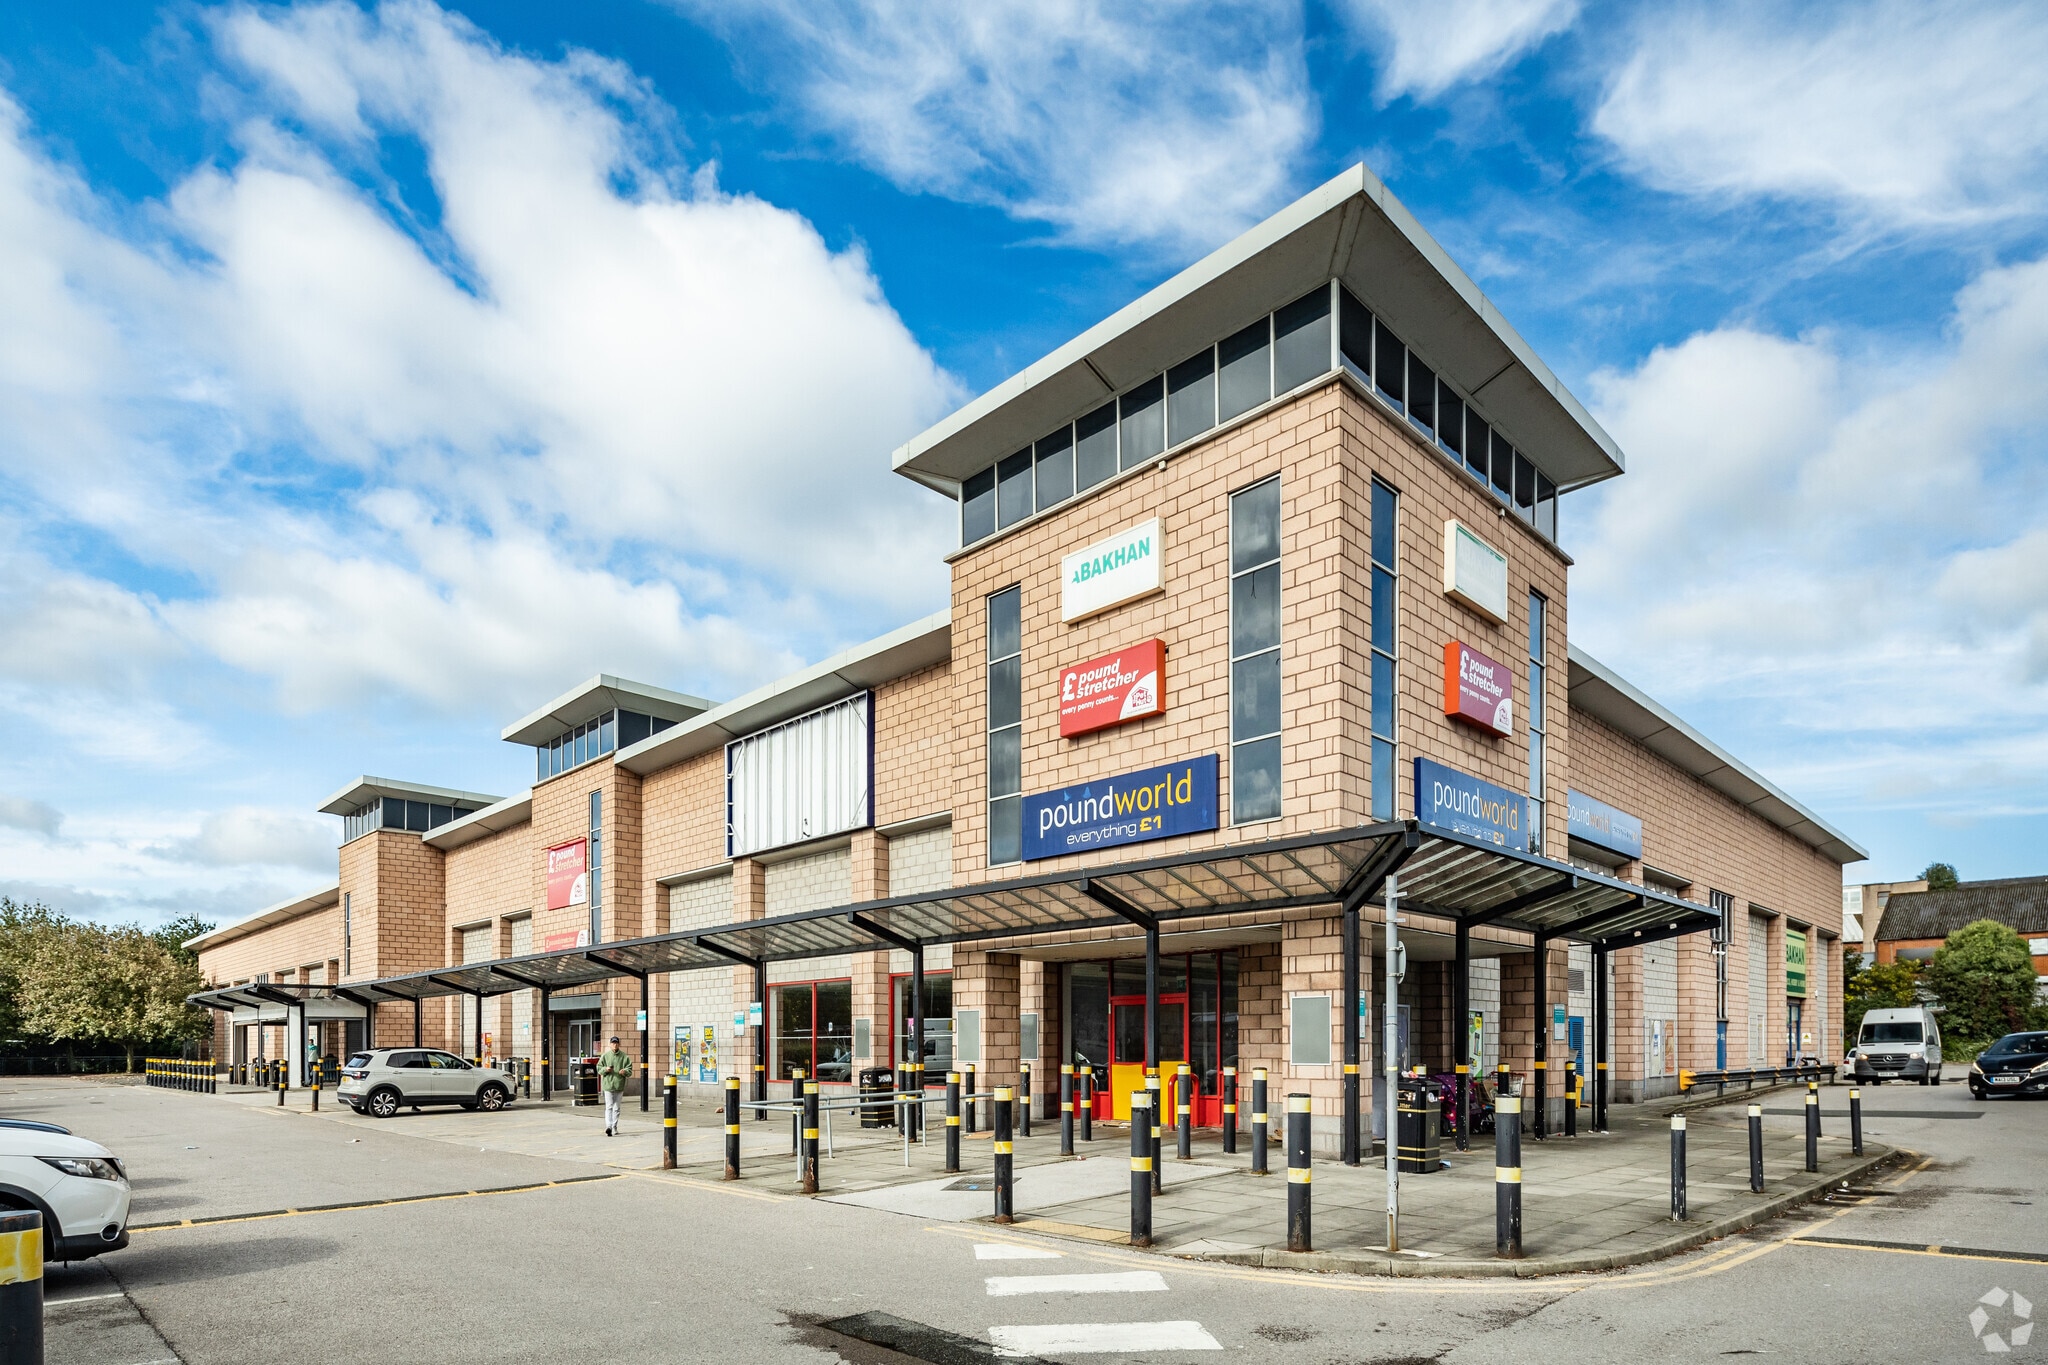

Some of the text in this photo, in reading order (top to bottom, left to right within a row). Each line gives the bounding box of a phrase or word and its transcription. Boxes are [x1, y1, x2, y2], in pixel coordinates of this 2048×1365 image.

[1078, 658, 1120, 689] pound
[1469, 659, 1494, 680] pound
[1076, 669, 1139, 699] stretcher
[1468, 672, 1503, 698] stretcher
[1062, 706, 1077, 716] every
[1077, 701, 1095, 712] penny
[1040, 768, 1192, 839] poundworld
[1434, 780, 1518, 831] poundworld
[1066, 815, 1161, 845] everything £1
[555, 857, 584, 872] stretcher
[556, 845, 576, 863] pound
